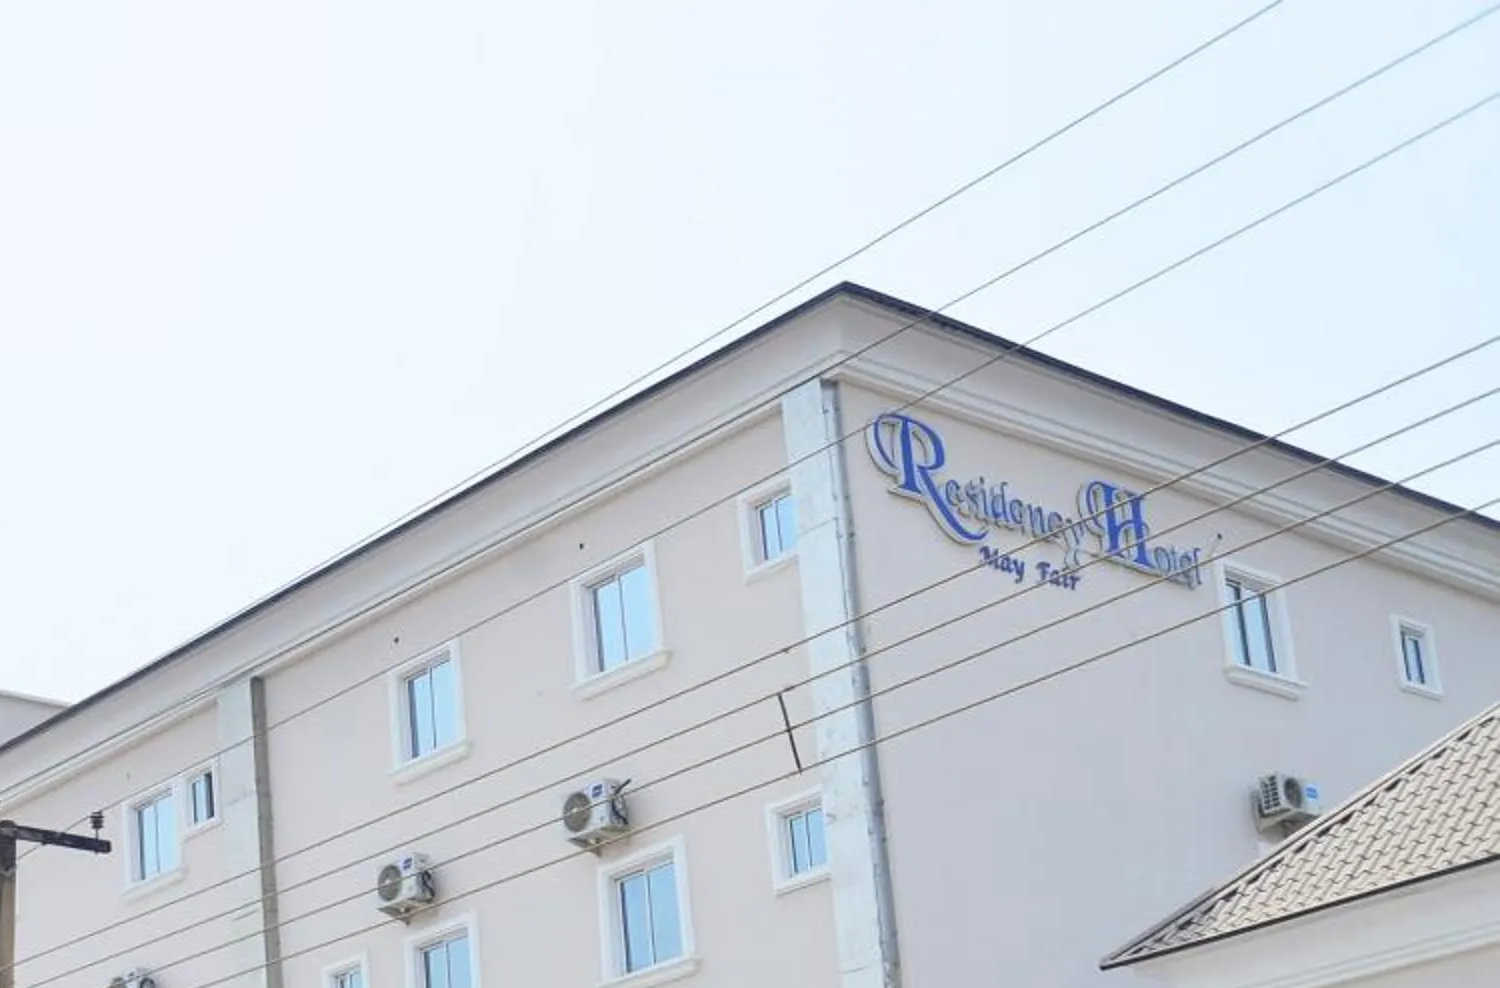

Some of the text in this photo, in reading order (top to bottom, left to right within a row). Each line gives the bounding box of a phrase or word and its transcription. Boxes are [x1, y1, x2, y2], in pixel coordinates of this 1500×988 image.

[866, 412, 1202, 590] Residency Hotel
[979, 546, 1082, 591] May Fair
